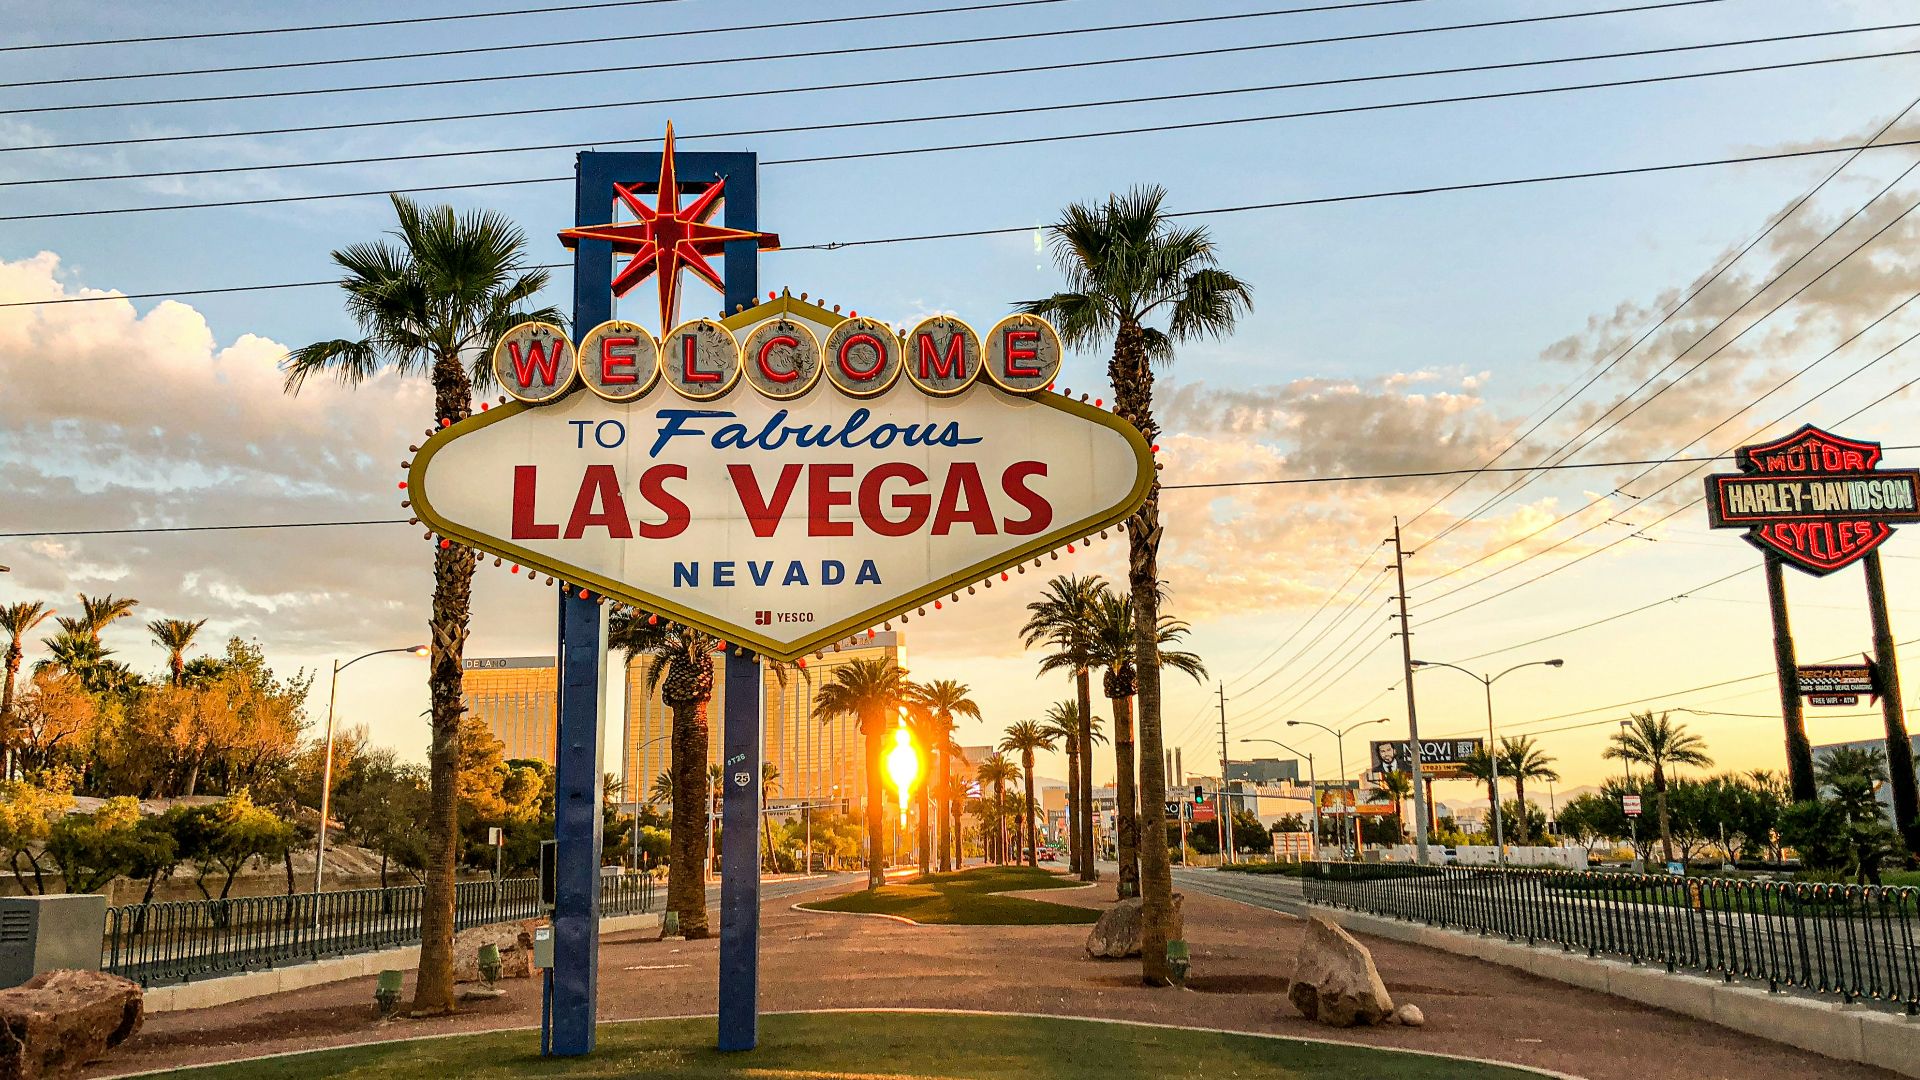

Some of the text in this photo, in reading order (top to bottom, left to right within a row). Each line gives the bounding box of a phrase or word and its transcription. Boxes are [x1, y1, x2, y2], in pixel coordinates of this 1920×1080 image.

[506, 331, 1042, 388] WELCOME
[568, 407, 984, 459] TO Fabulous
[1766, 438, 1865, 472] MOTOR
[511, 460, 1053, 540] LAS VEGAS
[1728, 480, 1913, 513] HARLEY-DAVIDSON
[1775, 521, 1873, 560] CYCLES
[673, 559, 882, 588] NEVADA
[777, 612, 813, 622] YESCO
[466, 659, 507, 668] DELANO
[735, 775, 749, 783] 25
